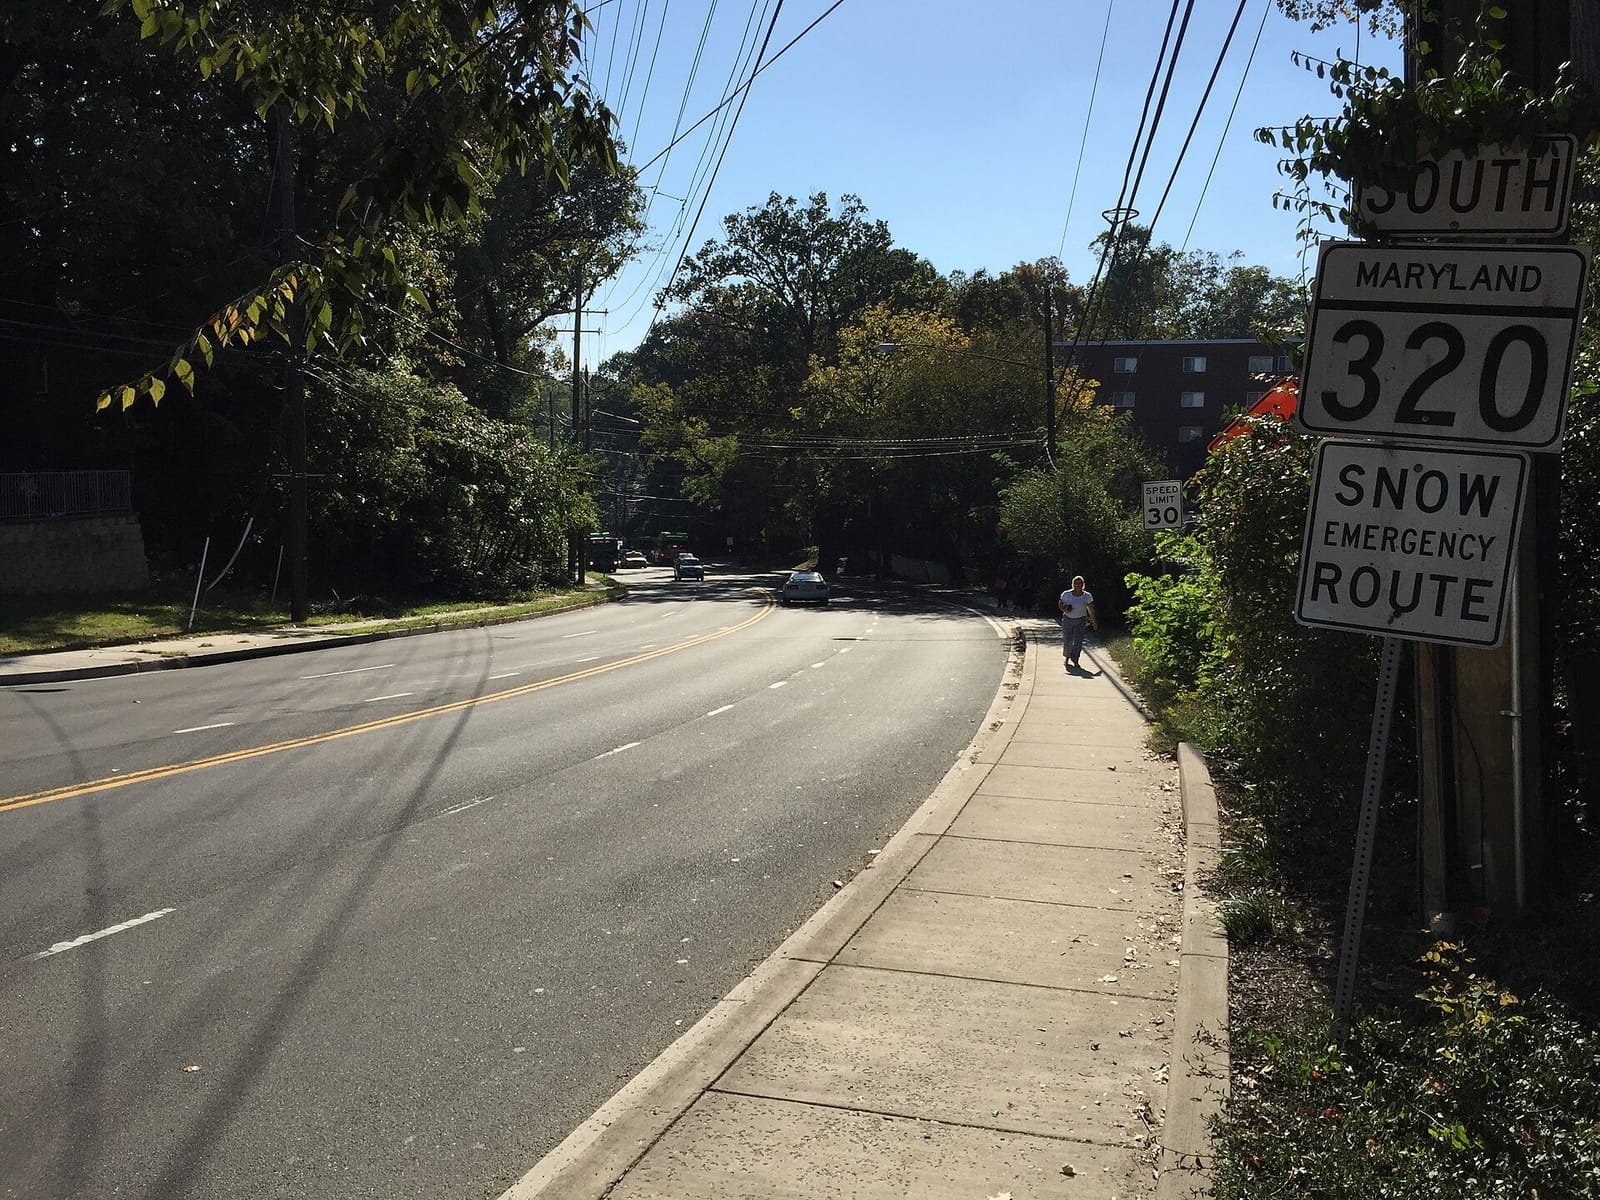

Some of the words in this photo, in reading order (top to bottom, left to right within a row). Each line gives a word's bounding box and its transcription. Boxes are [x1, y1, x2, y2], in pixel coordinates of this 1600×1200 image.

[1356, 261, 1543, 292] MARYLAND
[1320, 319, 1549, 433] 320
[1145, 486, 1179, 495] SPEED
[1149, 496, 1175, 504] LIMIT
[1335, 464, 1501, 518] SNOW
[1147, 507, 1179, 525] 30
[1323, 521, 1496, 562] EMERGENCY
[1311, 561, 1494, 623] ROUTE
